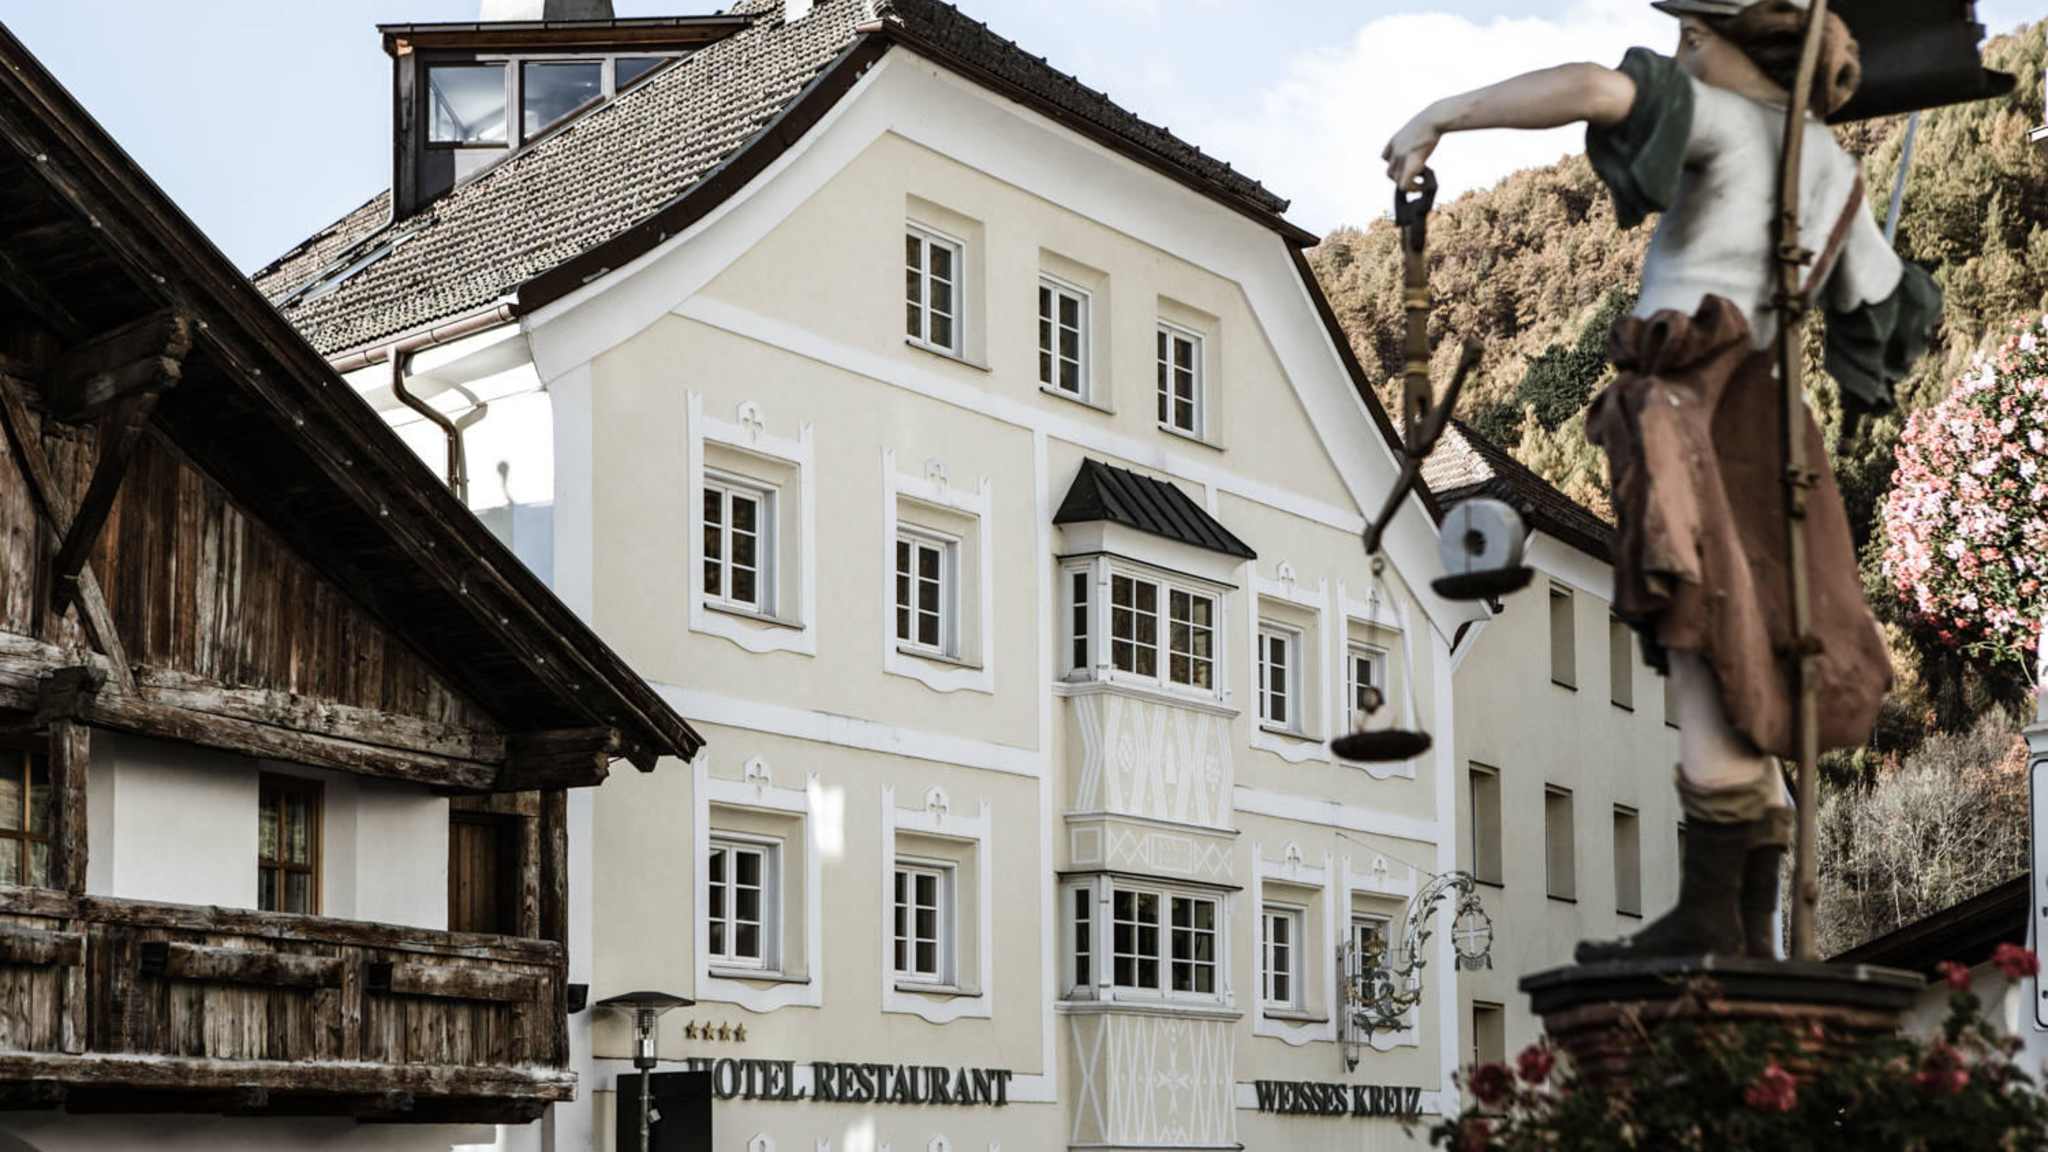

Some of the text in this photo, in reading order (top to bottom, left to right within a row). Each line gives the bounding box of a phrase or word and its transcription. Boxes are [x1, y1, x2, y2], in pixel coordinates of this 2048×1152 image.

[811, 1061, 1012, 1106] RESTAURANT
[1256, 1080, 1423, 1118] WEISSES KREUZ
